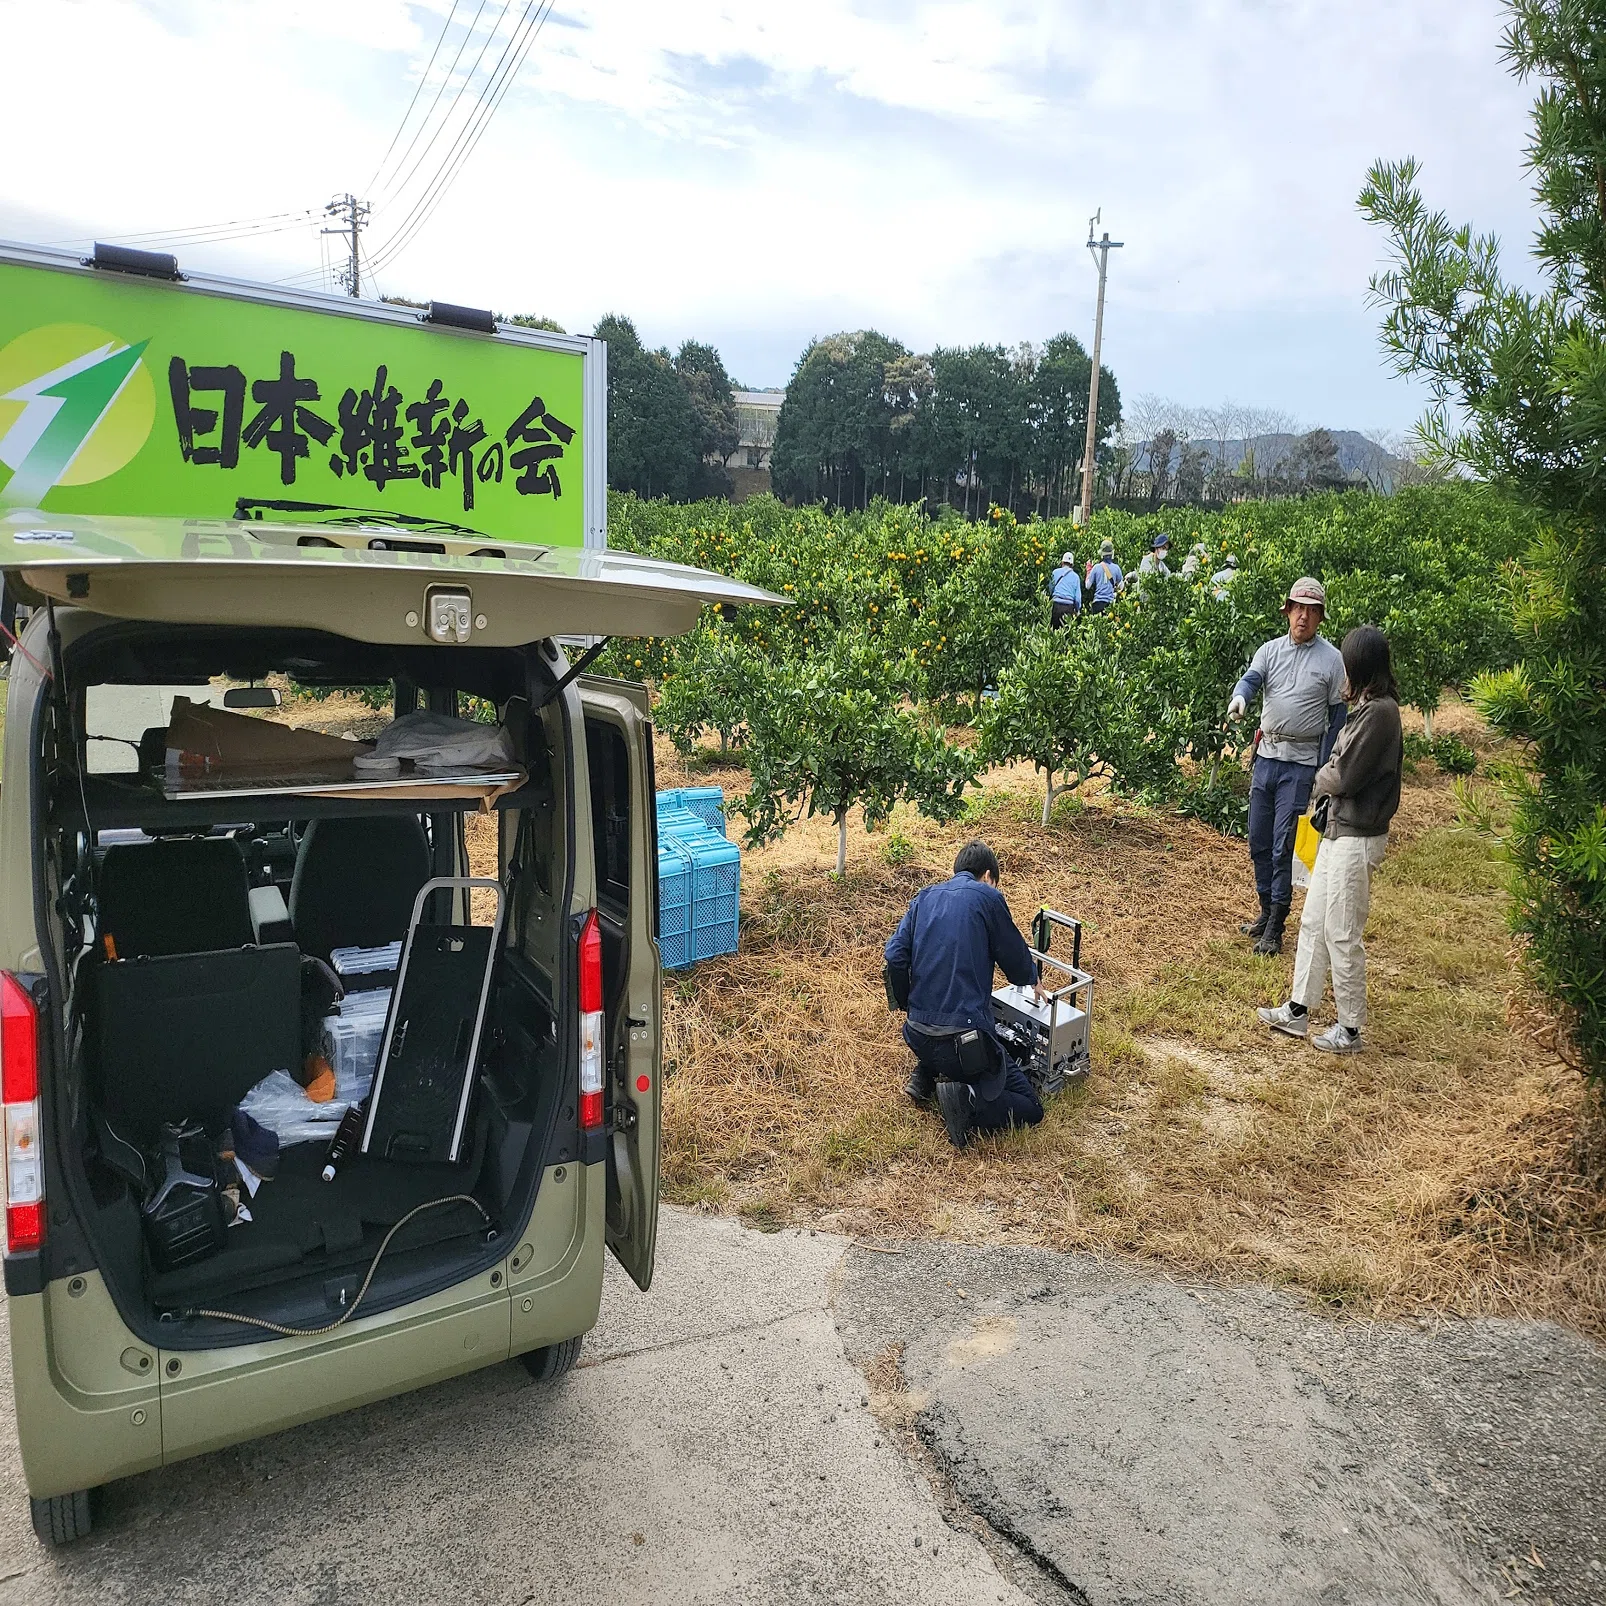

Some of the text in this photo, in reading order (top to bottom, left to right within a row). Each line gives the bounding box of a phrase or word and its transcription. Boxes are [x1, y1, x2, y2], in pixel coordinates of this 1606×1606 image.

[169, 351, 575, 511] 日本維新の会
